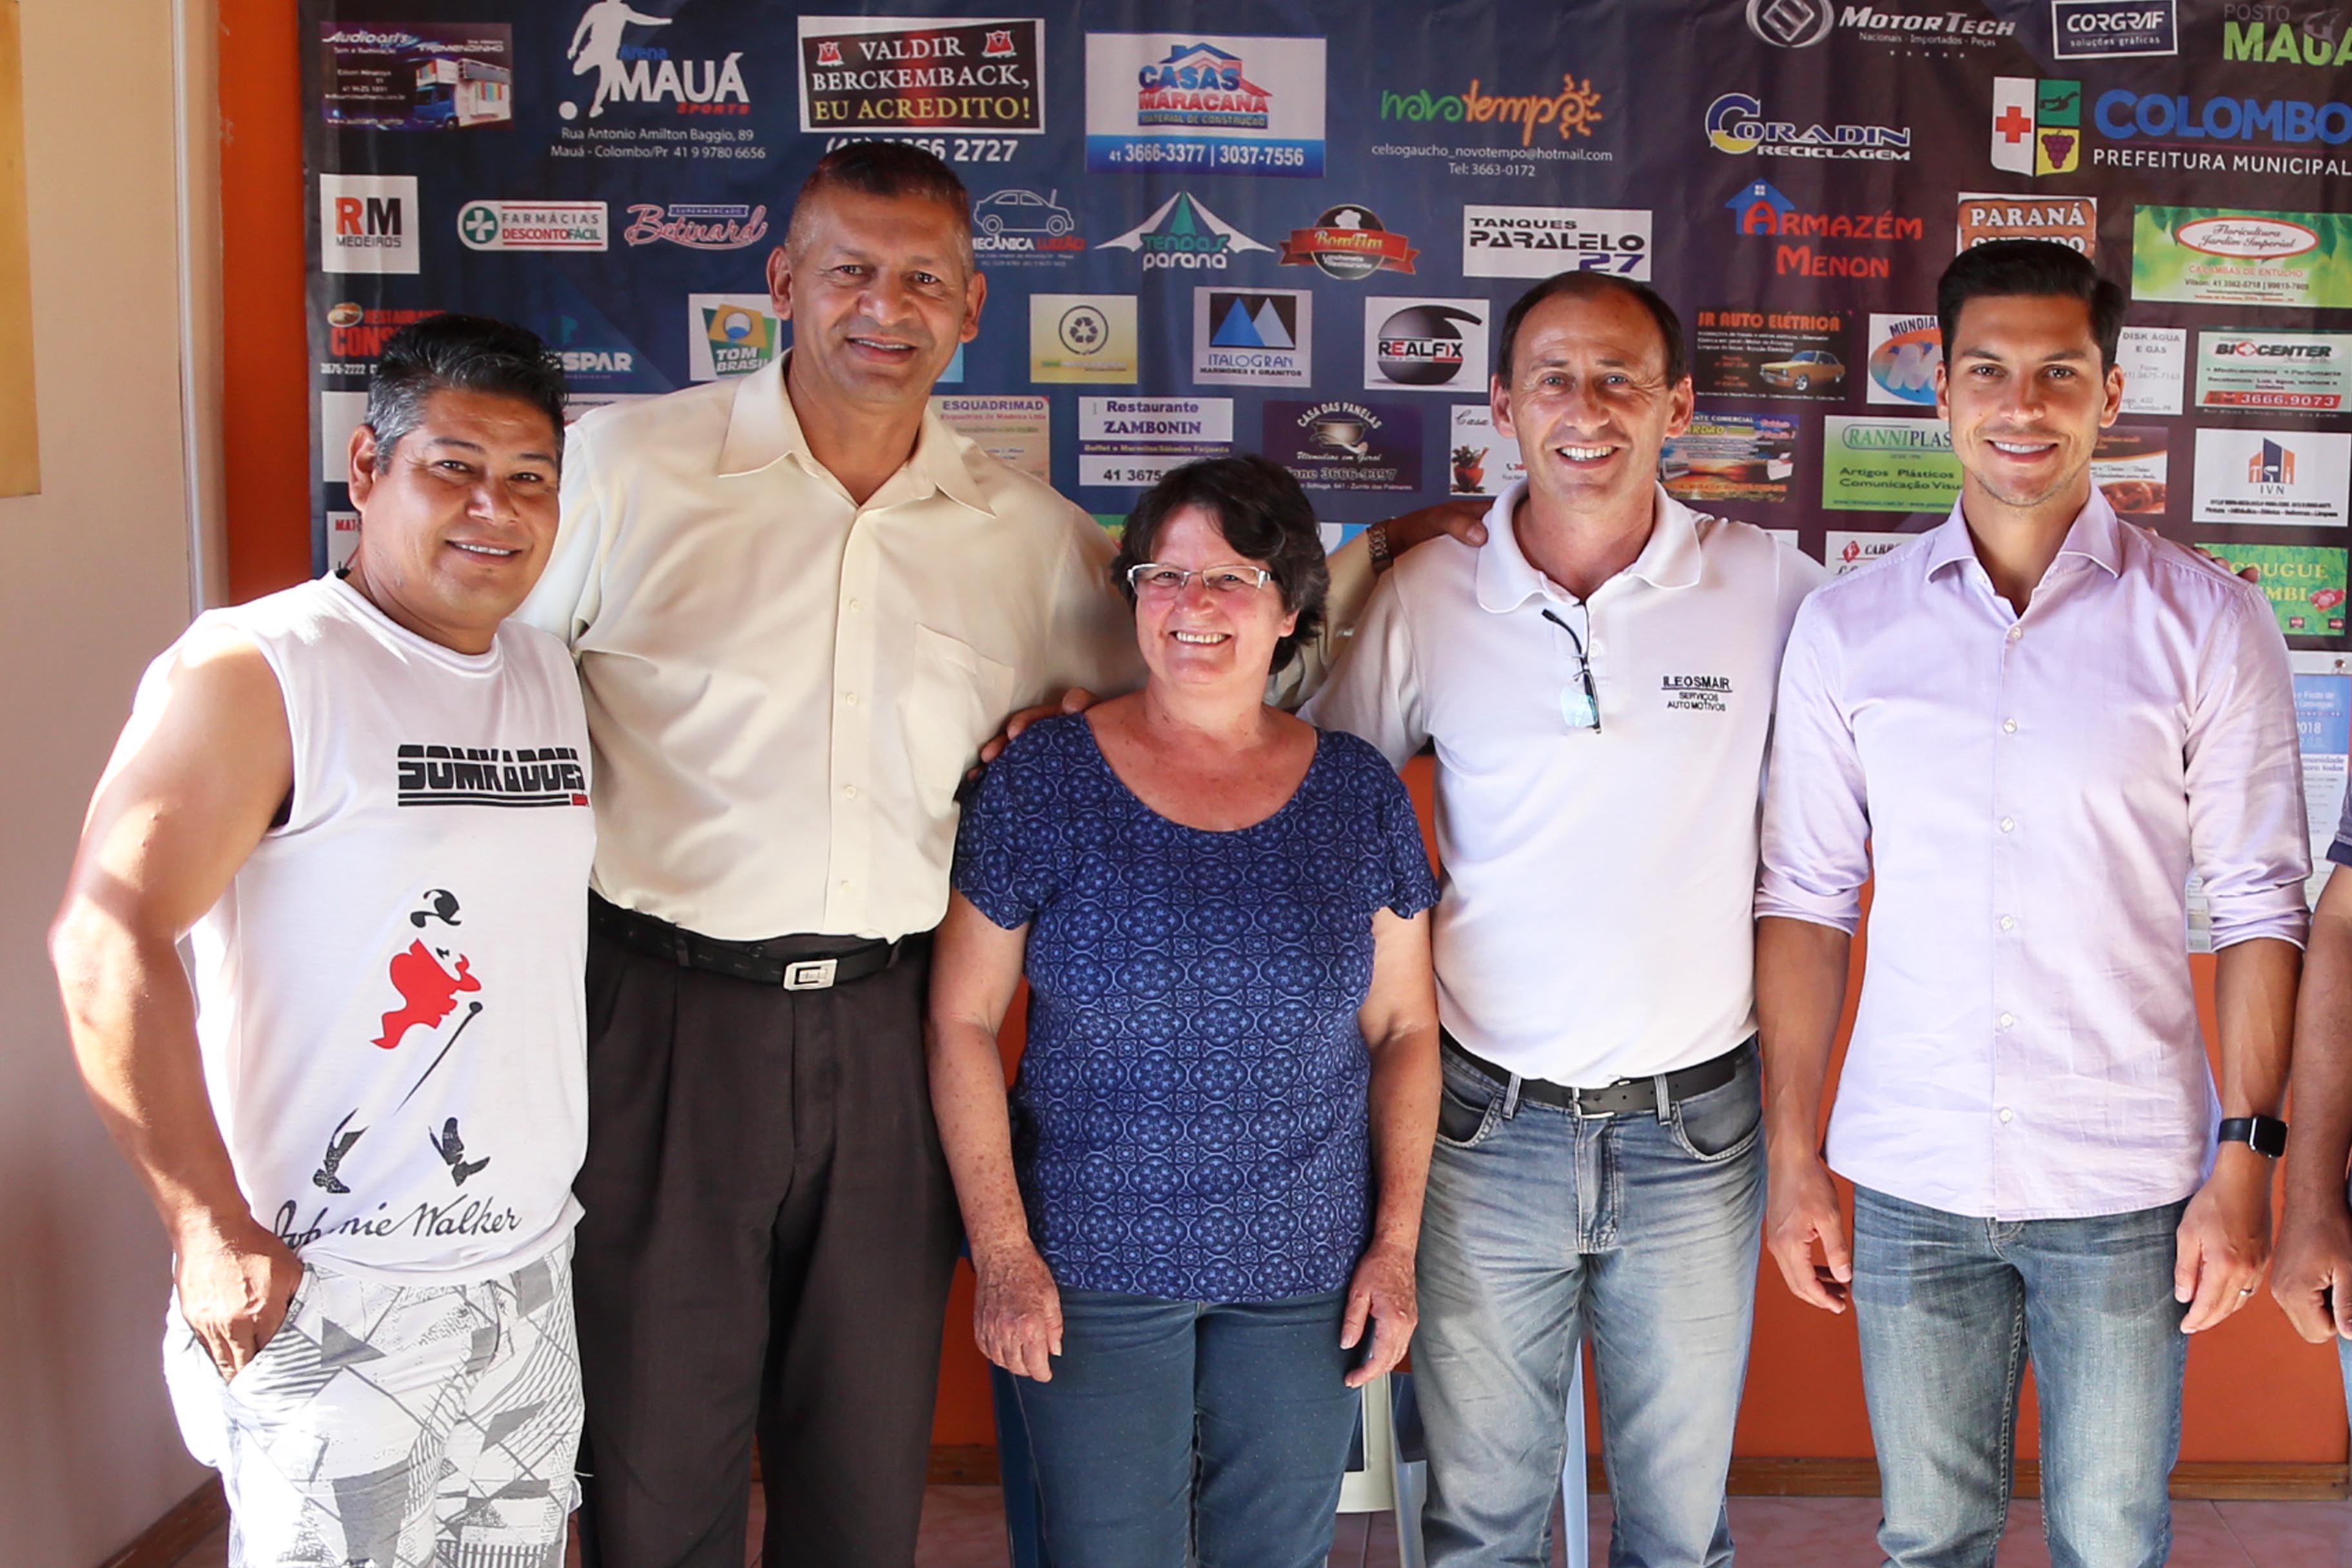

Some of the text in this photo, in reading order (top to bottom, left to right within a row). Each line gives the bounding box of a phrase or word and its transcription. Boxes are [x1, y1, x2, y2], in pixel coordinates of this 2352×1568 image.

[2224, 5, 2289, 21] POSTO
[2067, 12, 2164, 32] CORGRAF
[1859, 32, 1996, 47] Nacionais Importados Peças
[2071, 36, 2161, 48] soluções gráficas
[619, 44, 668, 59] Arena
[859, 36, 964, 61] VALDIR
[610, 52, 750, 103] MAUÁ
[811, 65, 1029, 91] BERCKEMBACK,
[1138, 64, 1240, 91] CASAS
[677, 103, 750, 114] SPORTS
[814, 97, 1030, 121] EU ACREDITO!
[1139, 92, 1269, 113] MARACANA
[1380, 89, 1464, 121] novo
[1705, 93, 1910, 154] CORADIN
[2094, 89, 2352, 144] COLOMBO
[562, 128, 754, 143] Rua Antonio Amilton Baggio, 89
[551, 146, 584, 157] Mauá
[595, 145, 669, 158] Colombo/Pr
[674, 146, 688, 157] 41
[691, 146, 699, 157] 9
[701, 146, 732, 159] 9780
[735, 147, 766, 159] 6656
[954, 139, 1019, 161] 2727
[1109, 150, 1121, 161] 41
[1125, 143, 1206, 162] 3666-3377
[1220, 145, 1304, 166] 3037-7556
[1757, 145, 1910, 161] RECICLAGEM
[1448, 162, 1536, 177] Tel: 3663-0172
[2093, 149, 2352, 176] PREFEITURA MUNICIPAL
[335, 197, 402, 235] RM
[502, 211, 598, 224] FARMÁCIAS
[1743, 199, 1924, 239] ARMAZÉM
[1971, 202, 2086, 226] PARANÁ
[1470, 218, 1577, 230] TANQUES
[336, 237, 402, 248] MEDEIROS
[1469, 231, 1645, 251] PARALELO
[1580, 252, 1645, 273] 27
[1776, 244, 1890, 278] MENON
[1720, 312, 1764, 328] AUTO
[1769, 311, 1840, 331] ELÉTRICA
[2122, 331, 2148, 340] DISK
[716, 348, 758, 360] TOM
[1208, 355, 1293, 367] ITALOGRAN
[942, 401, 1044, 410] ESQUADRIMAD
[1106, 401, 1199, 413] Restaurante
[2240, 393, 2335, 407] 3666.9073
[1297, 402, 1382, 429] CASA DAS PANELAS
[1711, 415, 1754, 423] COMERCIAL
[1104, 421, 1200, 434] ZAMBONIN
[1103, 470, 1121, 481] 41
[1839, 467, 1954, 478] Artigos Plásticos
[1839, 478, 1930, 489] Comunicação
[2261, 485, 2284, 495] IVN
[391, 1193, 522, 1237] Walker
